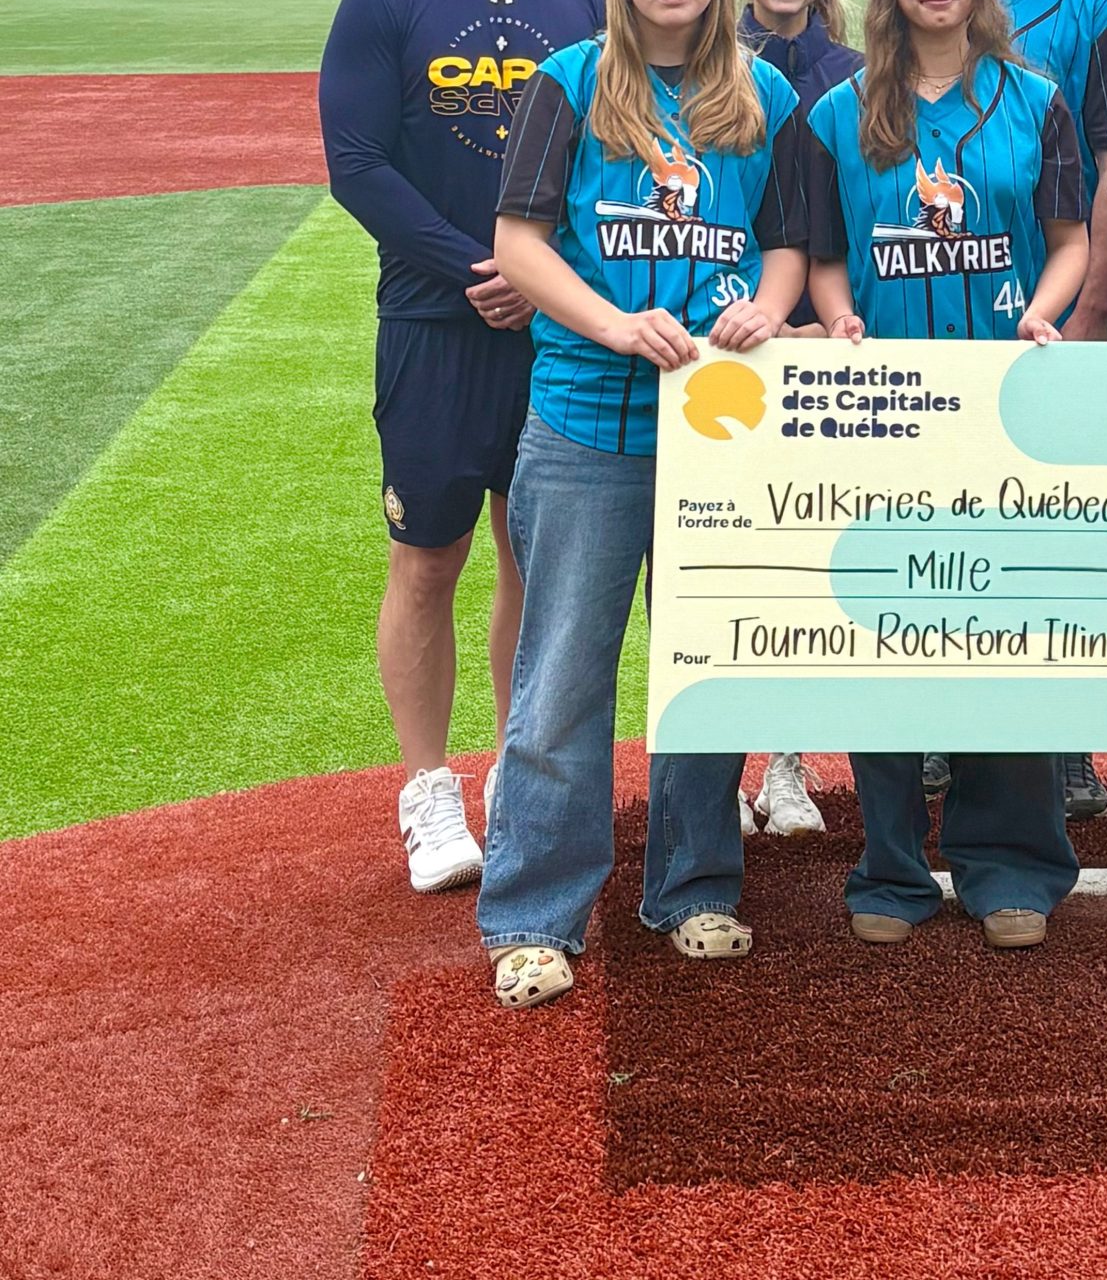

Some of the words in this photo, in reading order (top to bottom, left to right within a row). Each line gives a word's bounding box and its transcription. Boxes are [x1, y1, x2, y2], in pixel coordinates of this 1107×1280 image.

[428, 56, 538, 89] CAP
[600, 223, 746, 262] VALKYRIES
[872, 236, 1012, 277] VALKYRIES
[711, 272, 749, 307] 30
[993, 278, 1025, 319] 44
[783, 364, 922, 387] Fondation
[781, 390, 829, 411] des
[836, 390, 961, 416] Capitales
[781, 417, 814, 437] de
[820, 417, 921, 439] Québec
[678, 498, 723, 514] Payez
[727, 499, 736, 512] à
[767, 481, 935, 524] Valkiries
[951, 488, 985, 518] de
[678, 515, 729, 529] l'ordre
[732, 515, 752, 528] de
[908, 550, 990, 592] Mille
[729, 616, 855, 661] Tournoi
[877, 612, 1028, 660] Rockford
[673, 652, 711, 665] Pour
